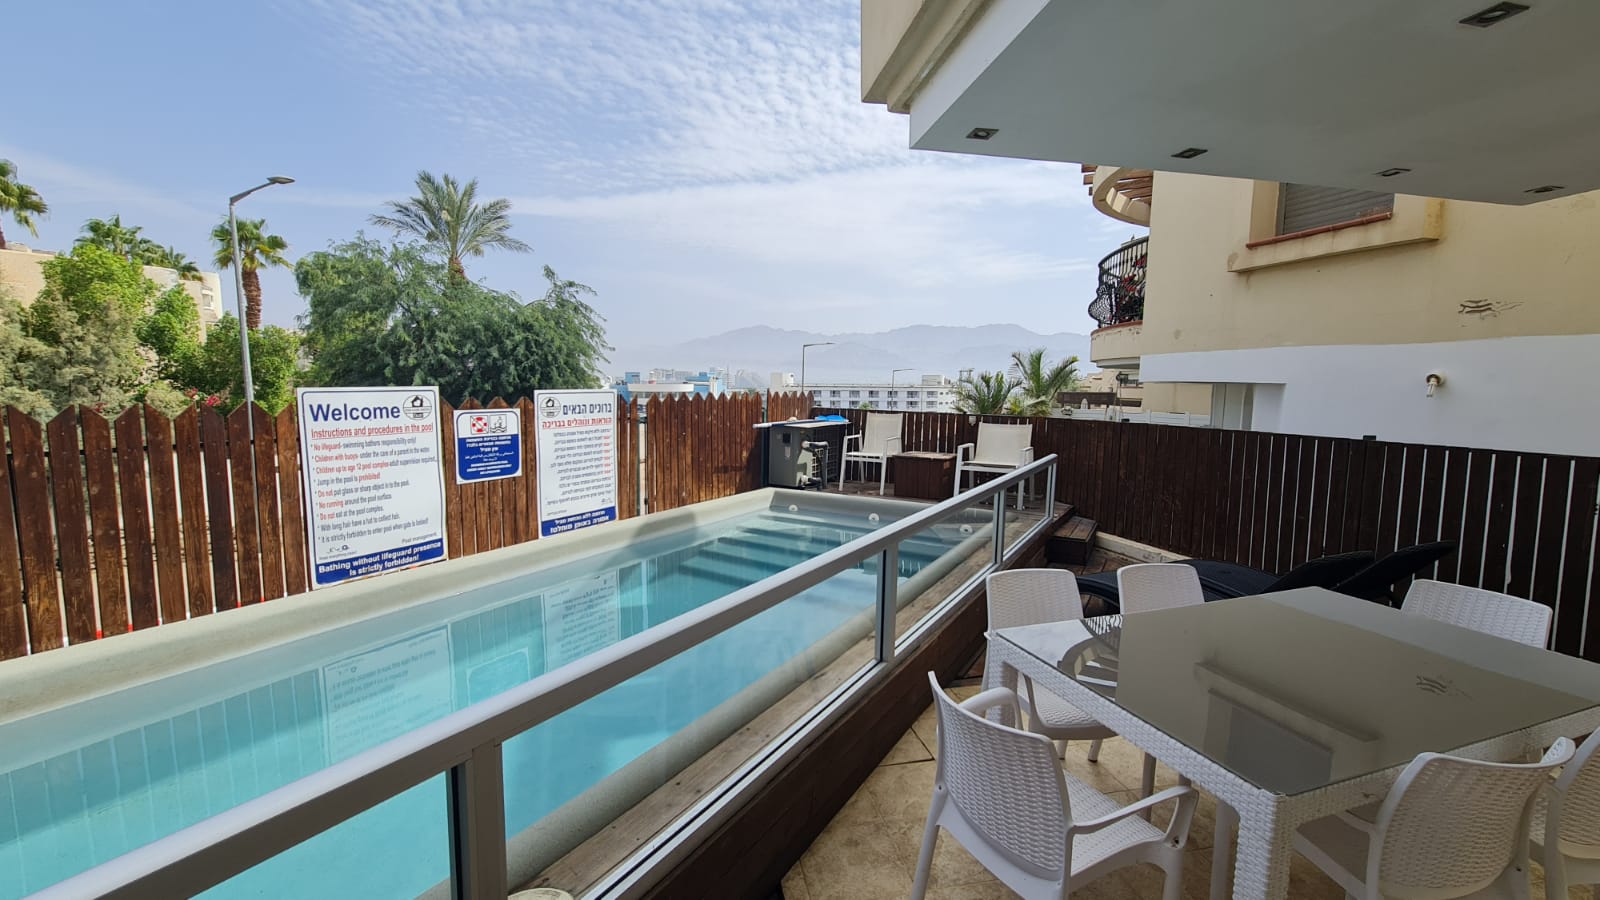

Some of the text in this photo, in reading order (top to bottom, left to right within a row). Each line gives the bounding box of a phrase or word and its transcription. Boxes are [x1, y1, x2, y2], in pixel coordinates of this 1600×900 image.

[309, 403, 400, 421] Welcome
[563, 404, 587, 415] הבאים
[589, 403, 612, 414] ברוכים
[311, 426, 352, 438] Instructions
[353, 426, 366, 435] and
[368, 424, 402, 436] procedures
[411, 423, 420, 431] the
[421, 422, 433, 432] pool
[317, 479, 329, 487] Jump
[327, 500, 343, 508] running
[318, 541, 442, 574] Bathing without lifeguard presence
[358, 562, 383, 574] strictly
[384, 554, 419, 569] forbidden!
